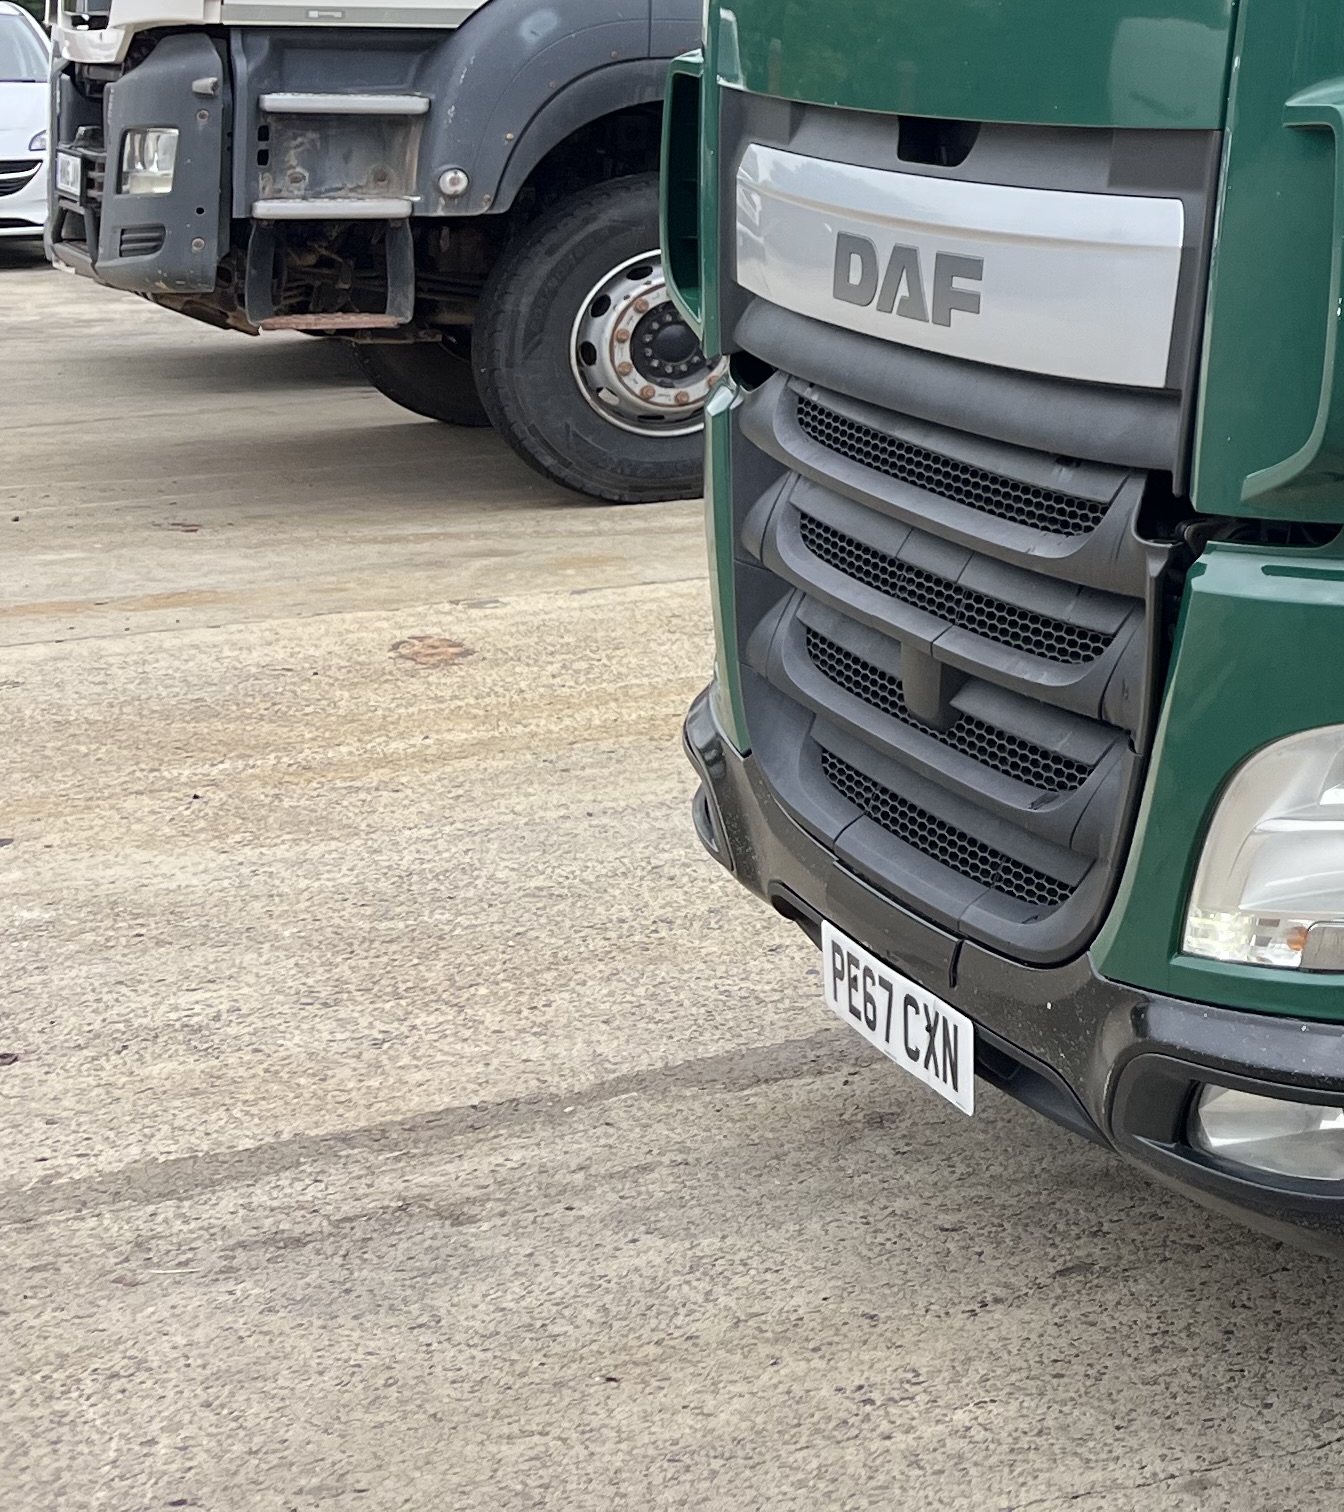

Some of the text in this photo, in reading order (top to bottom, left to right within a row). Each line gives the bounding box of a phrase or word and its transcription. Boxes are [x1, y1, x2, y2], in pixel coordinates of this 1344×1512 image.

[832, 230, 985, 328] DAF
[831, 940, 959, 1093] PE67 CXN
